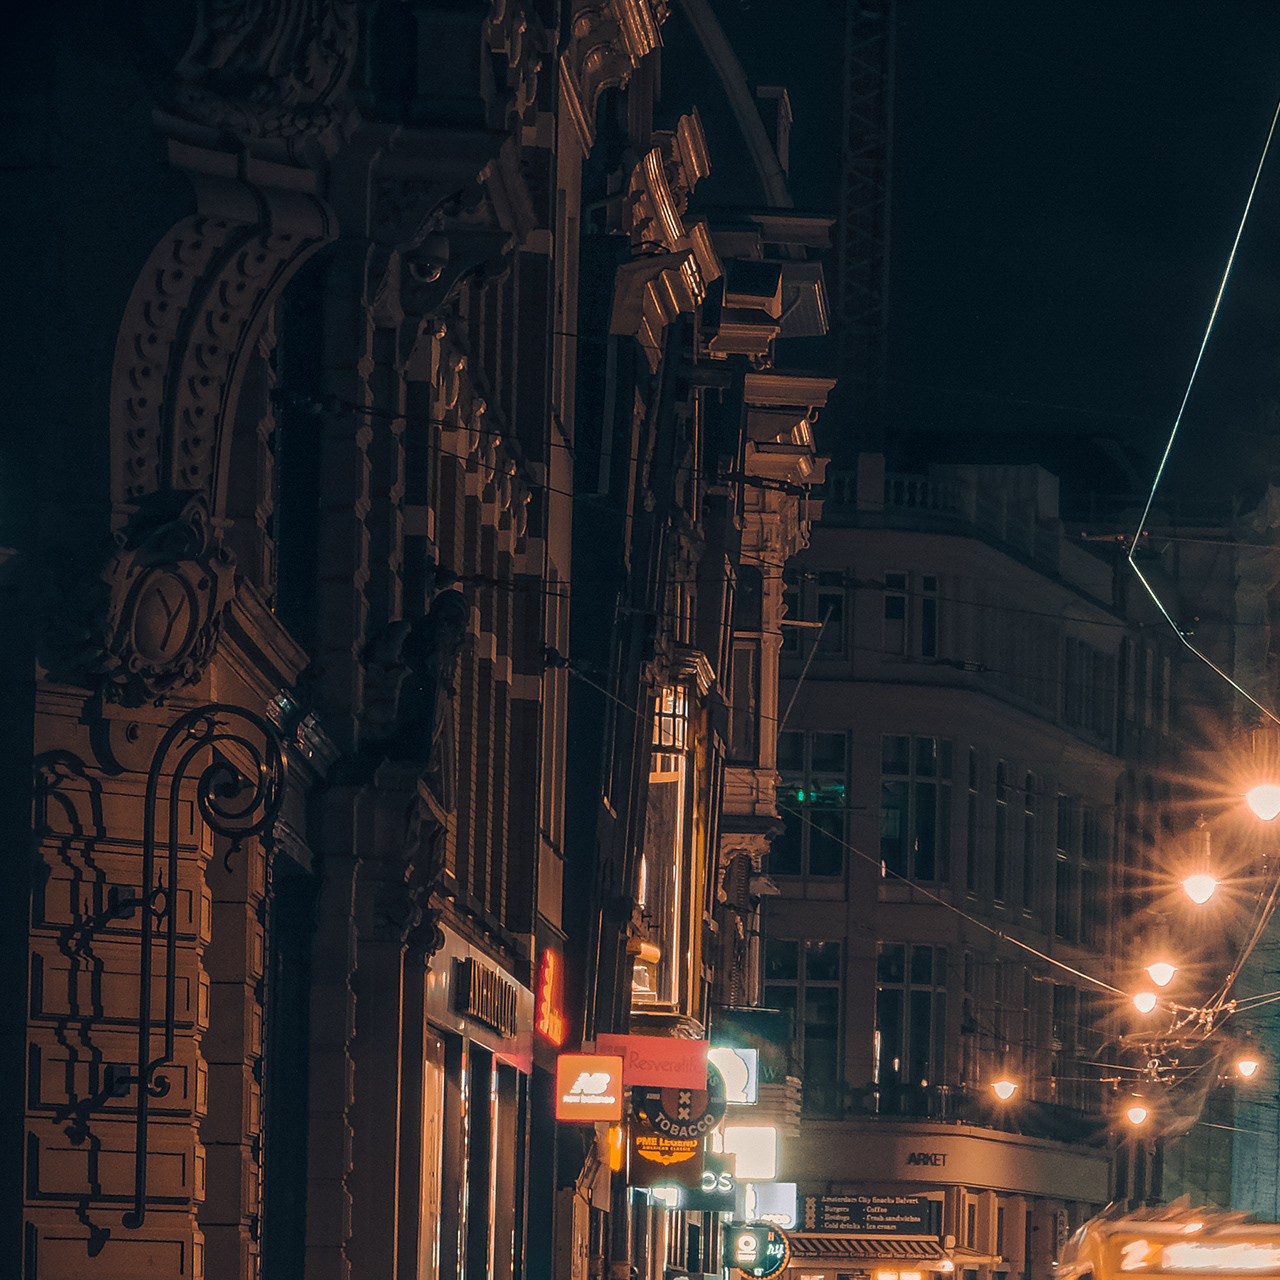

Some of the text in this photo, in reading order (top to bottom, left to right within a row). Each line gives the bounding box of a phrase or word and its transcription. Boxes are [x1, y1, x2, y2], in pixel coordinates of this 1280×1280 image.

[654, 1112, 715, 1137] TOBACCO
[906, 1152, 948, 1167] ARKET
[1057, 1210, 1066, 1247] ARKE
